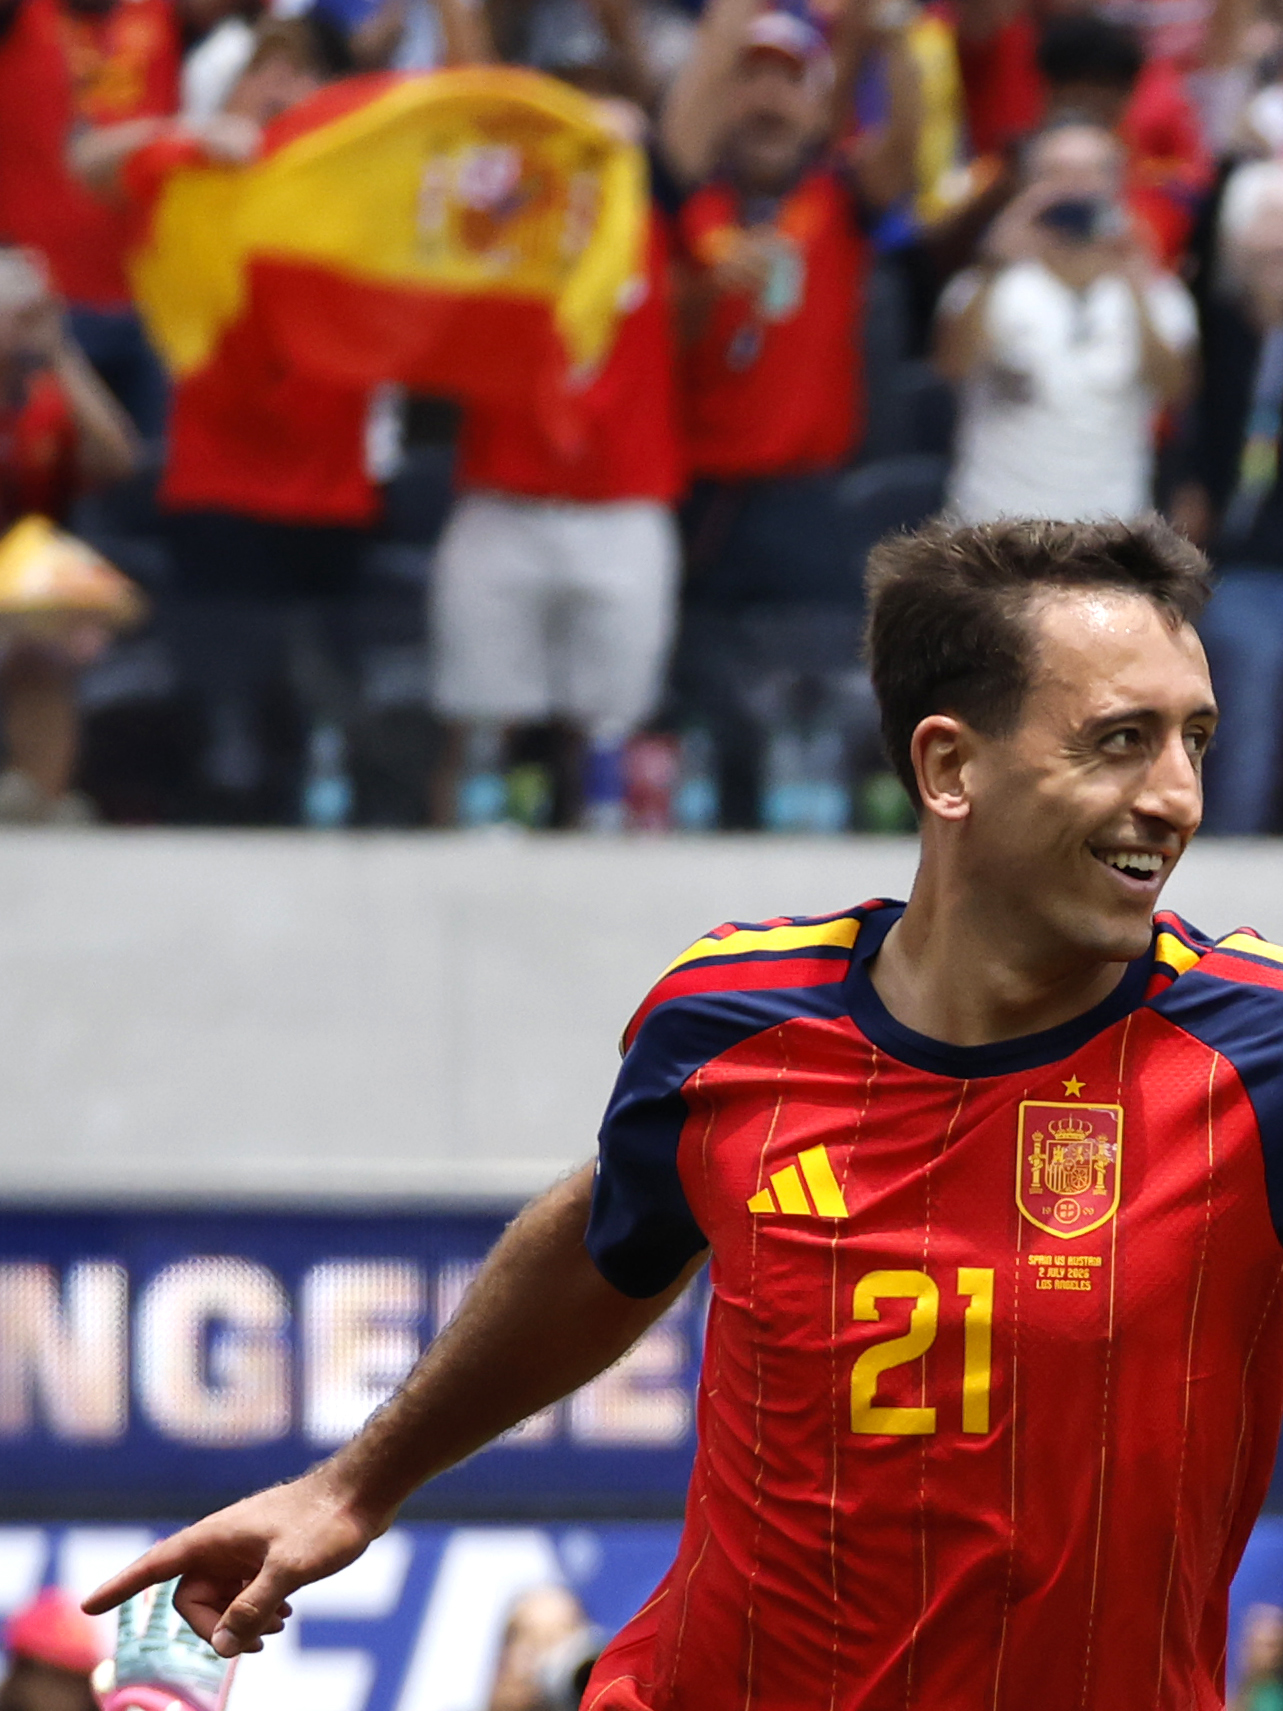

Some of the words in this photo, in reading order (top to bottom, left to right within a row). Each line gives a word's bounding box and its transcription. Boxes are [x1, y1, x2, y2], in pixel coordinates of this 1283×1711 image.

[1027, 1254, 1053, 1266] SPAIN
[1067, 1255, 1103, 1267] AUSTRIA
[1038, 1267, 1045, 1278] 2
[1046, 1267, 1066, 1278] JULY
[1067, 1267, 1091, 1279] 2026
[1035, 1279, 1053, 1290] LOS
[1054, 1279, 1092, 1291] ANGELES
[851, 1267, 995, 1435] 21
